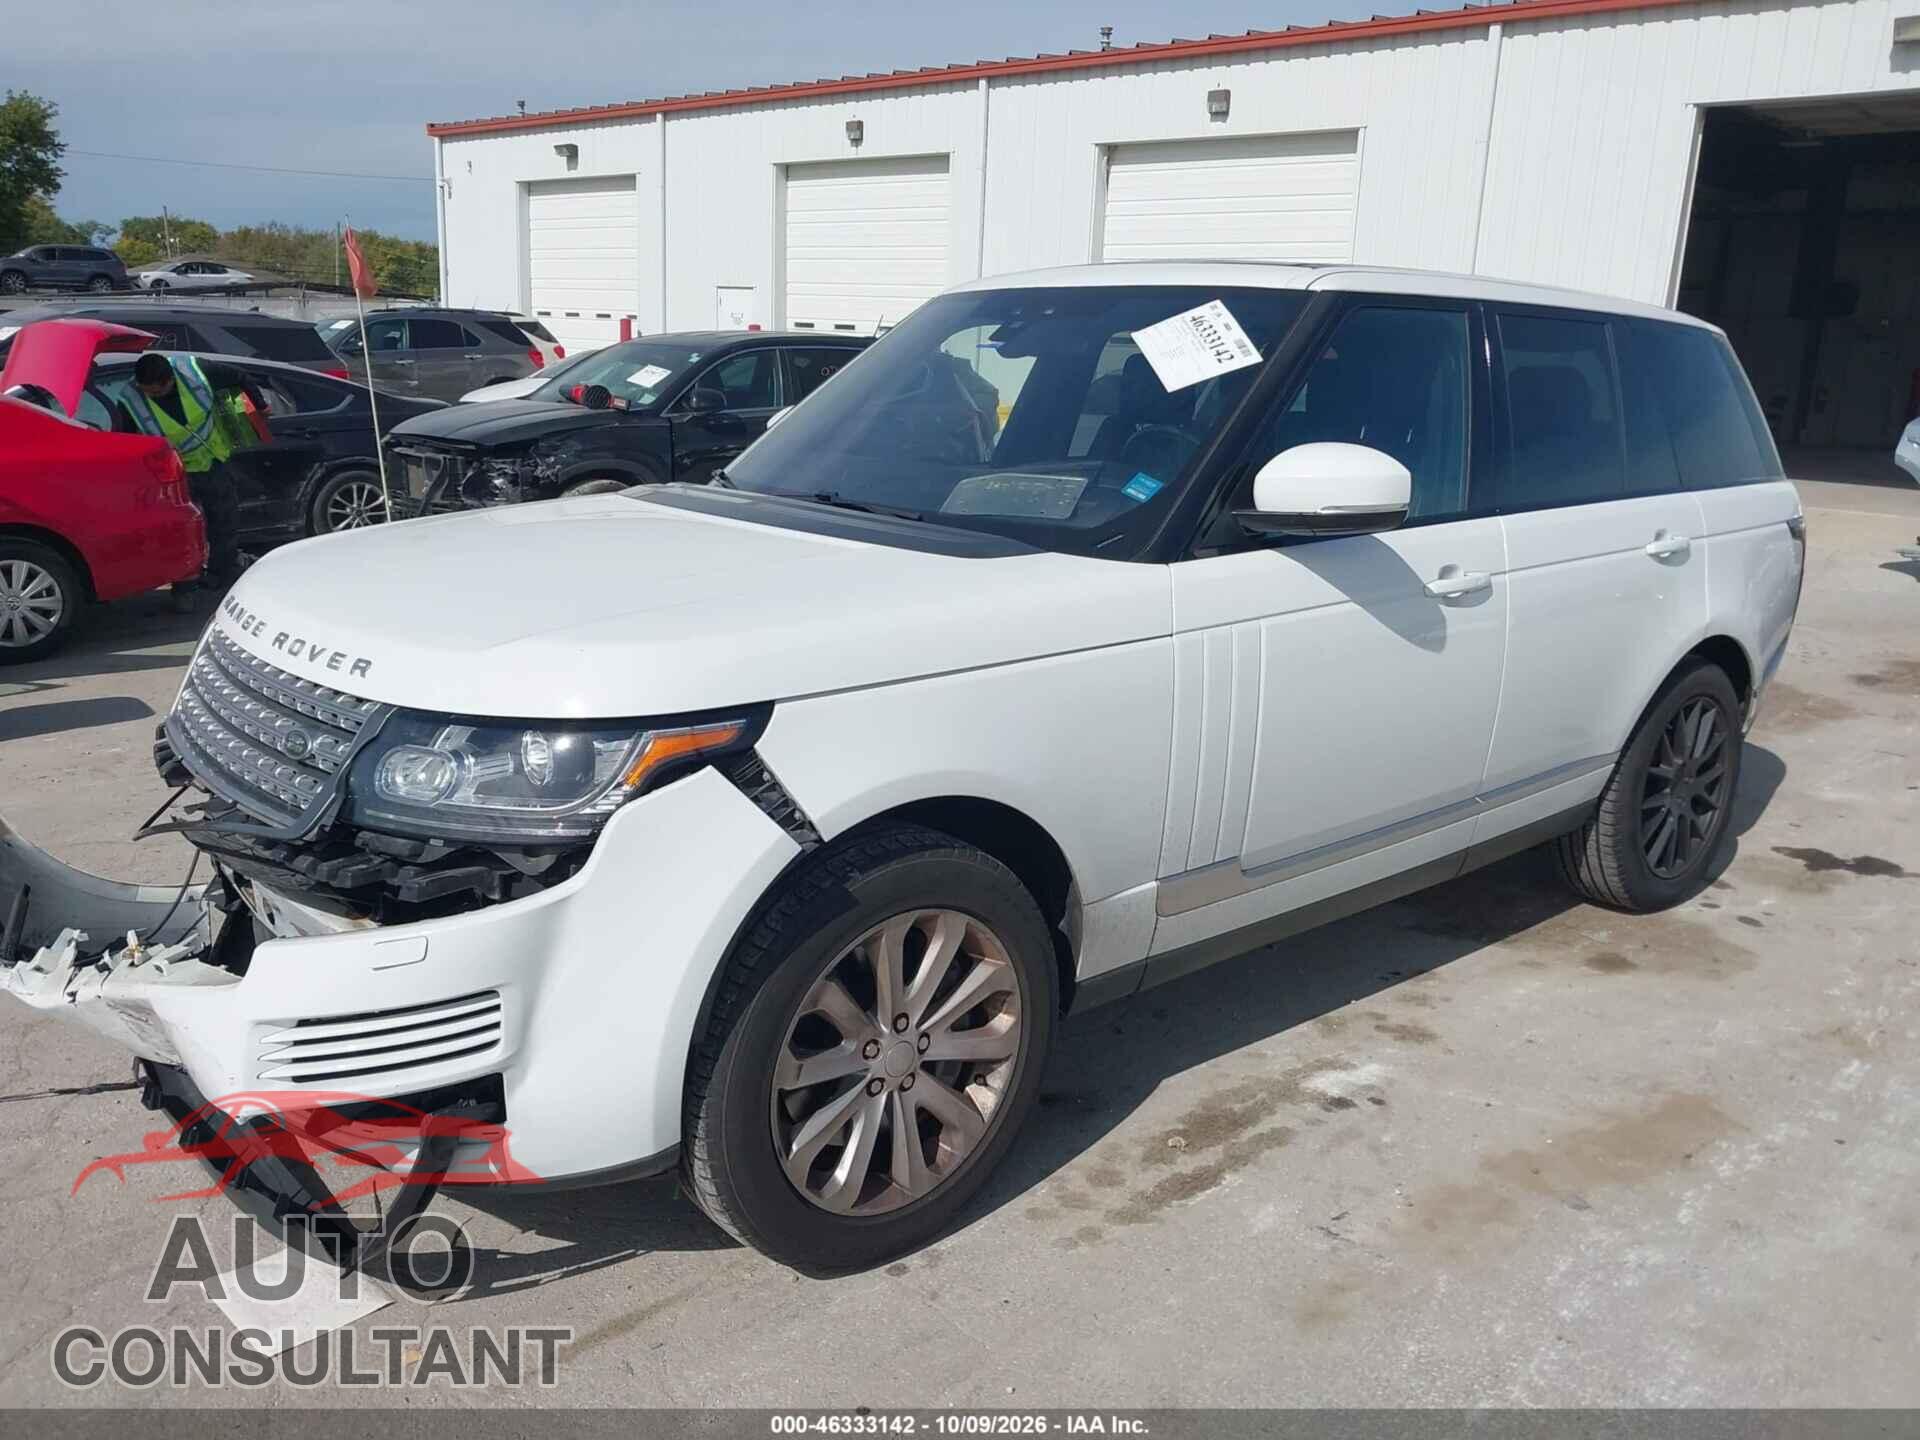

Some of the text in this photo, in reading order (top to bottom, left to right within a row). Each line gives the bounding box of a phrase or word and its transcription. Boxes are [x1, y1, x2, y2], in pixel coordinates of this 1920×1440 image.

[1189, 314, 1235, 365] 46333142
[223, 594, 373, 679] RANGE ROVER
